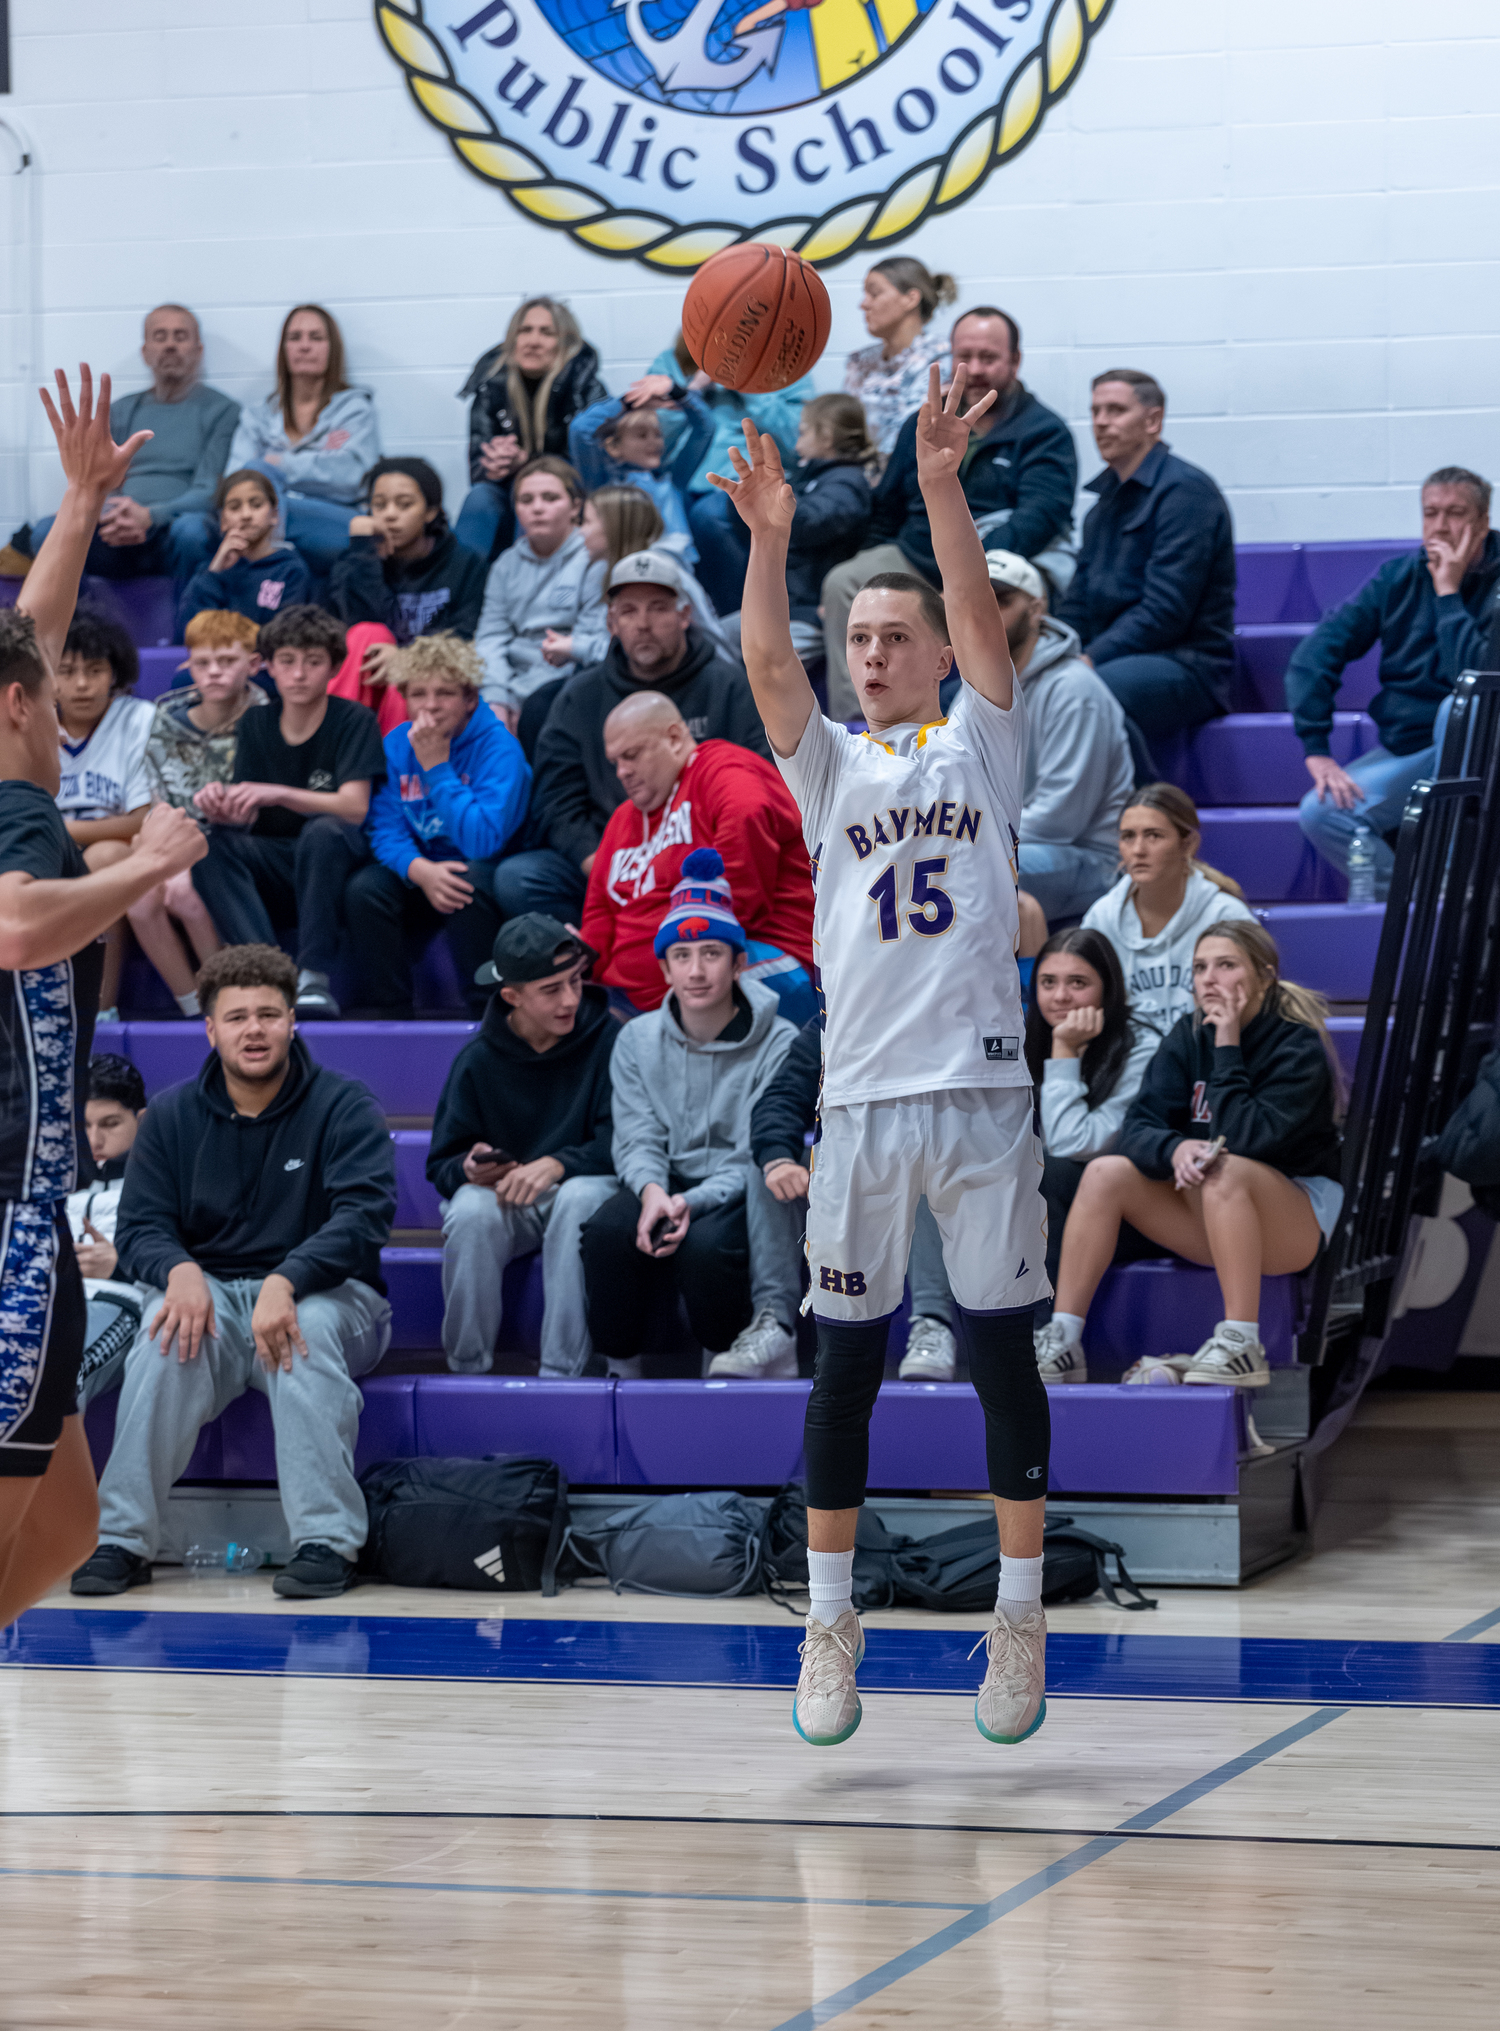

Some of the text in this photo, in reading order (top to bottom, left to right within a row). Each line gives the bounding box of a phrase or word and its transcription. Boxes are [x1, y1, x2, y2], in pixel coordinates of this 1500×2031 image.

[447, 0, 700, 192] Public
[713, 296, 769, 387] SPALDING
[844, 800, 984, 862] BAYMEN
[866, 855, 957, 943] 15
[819, 1265, 868, 1297] HB
